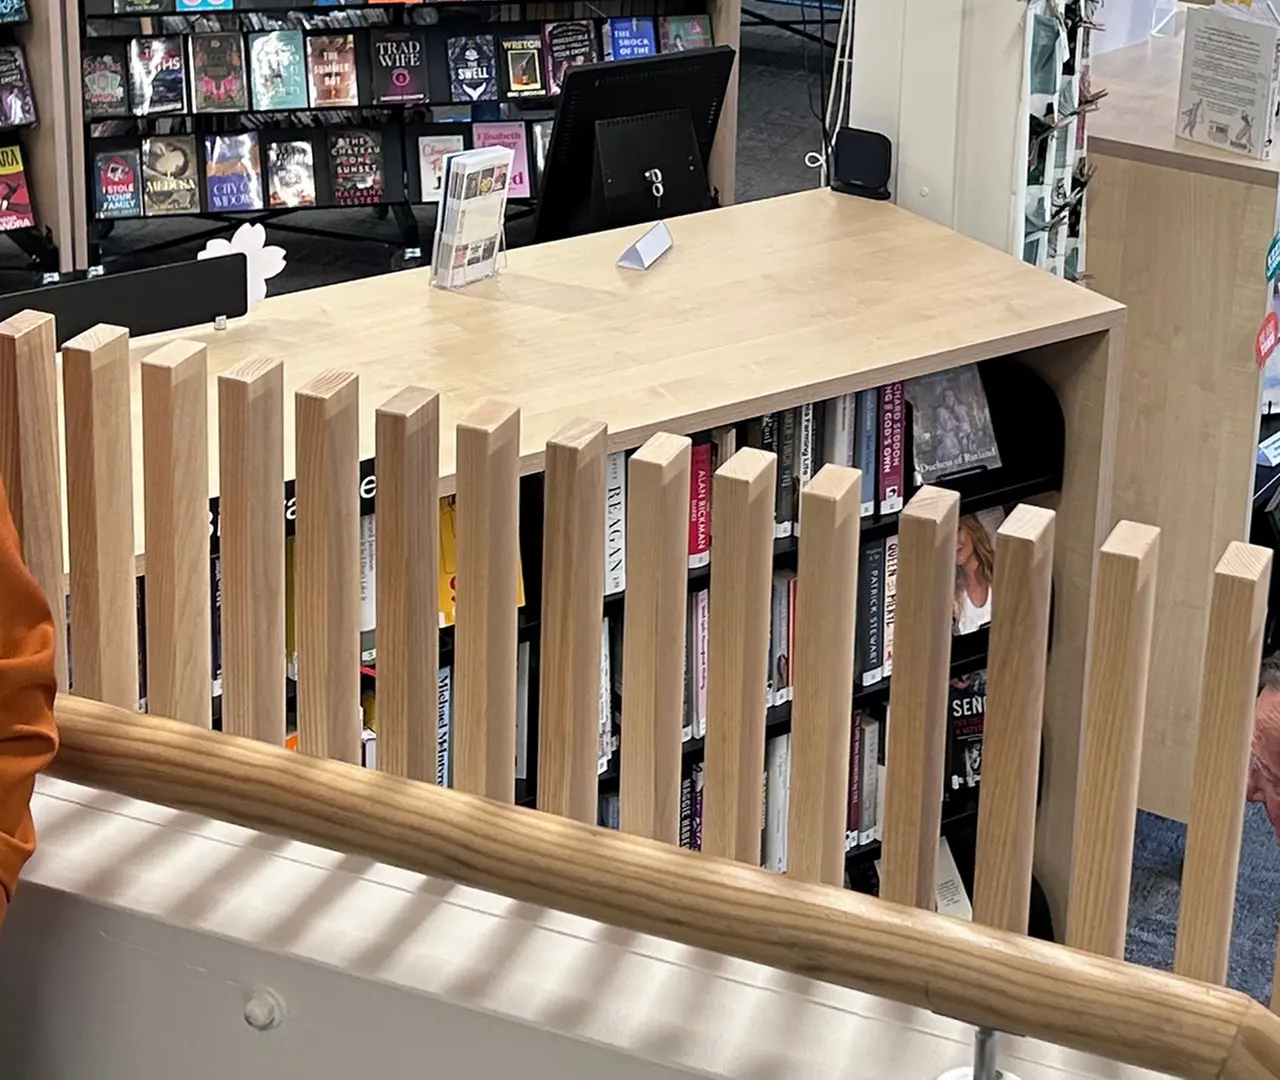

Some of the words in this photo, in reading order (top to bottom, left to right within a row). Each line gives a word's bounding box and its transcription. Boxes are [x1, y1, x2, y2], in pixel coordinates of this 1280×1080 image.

[376, 41, 421, 56] TRAD
[378, 54, 420, 68] WIFE
[620, 47, 633, 55] OF
[635, 46, 649, 55] THE
[457, 67, 489, 81] SWELL
[106, 193, 132, 203] YOUR
[108, 183, 134, 194] STOLE
[340, 197, 380, 206] LESTER
[102, 200, 136, 211] FAMILY
[893, 383, 903, 421] CHARD
[892, 422, 902, 467] SEDDON
[883, 447, 892, 474] OWN
[919, 460, 953, 475] Duchess
[954, 457, 962, 466] of
[964, 447, 997, 463] Rutland
[698, 470, 708, 499] ALAN
[606, 486, 622, 573] REAGAN
[698, 499, 709, 550] RICKMAN
[886, 543, 899, 577] QUEEN
[869, 570, 879, 615] PATRICK
[869, 616, 879, 665] STEWART
